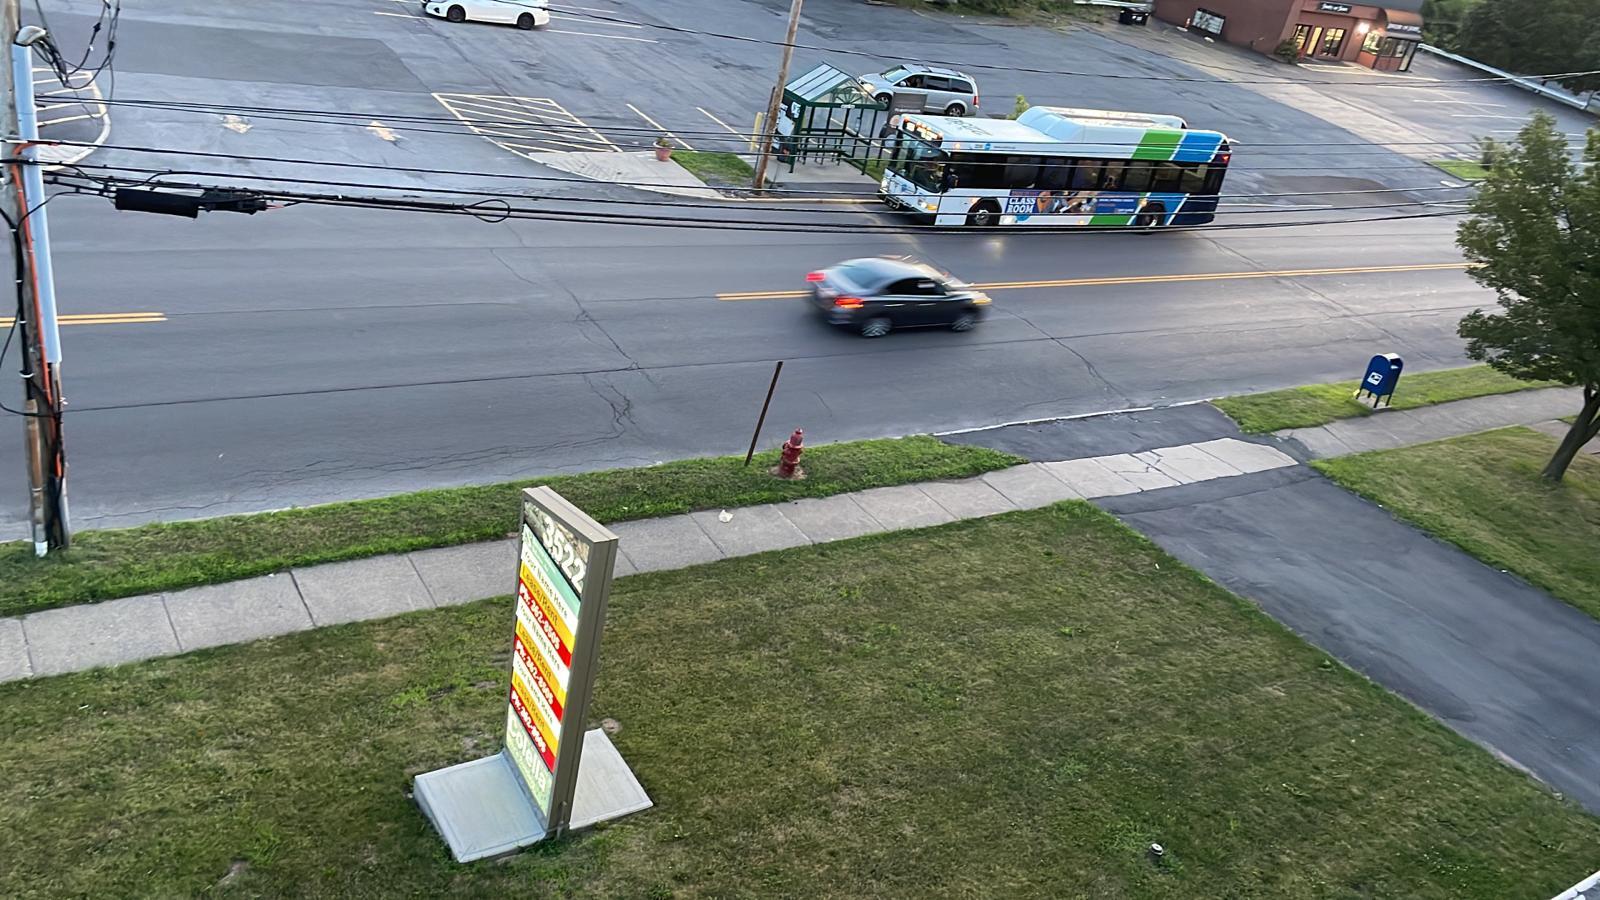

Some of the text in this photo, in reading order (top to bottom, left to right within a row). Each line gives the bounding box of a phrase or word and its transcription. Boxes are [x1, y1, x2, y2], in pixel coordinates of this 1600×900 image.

[1007, 204, 1034, 213] ROOM
[1009, 197, 1036, 205] CLASS
[542, 516, 587, 593] 3522
[522, 567, 560, 626] Lease/Rent
[538, 570, 552, 598] Name
[554, 592, 568, 618] Here
